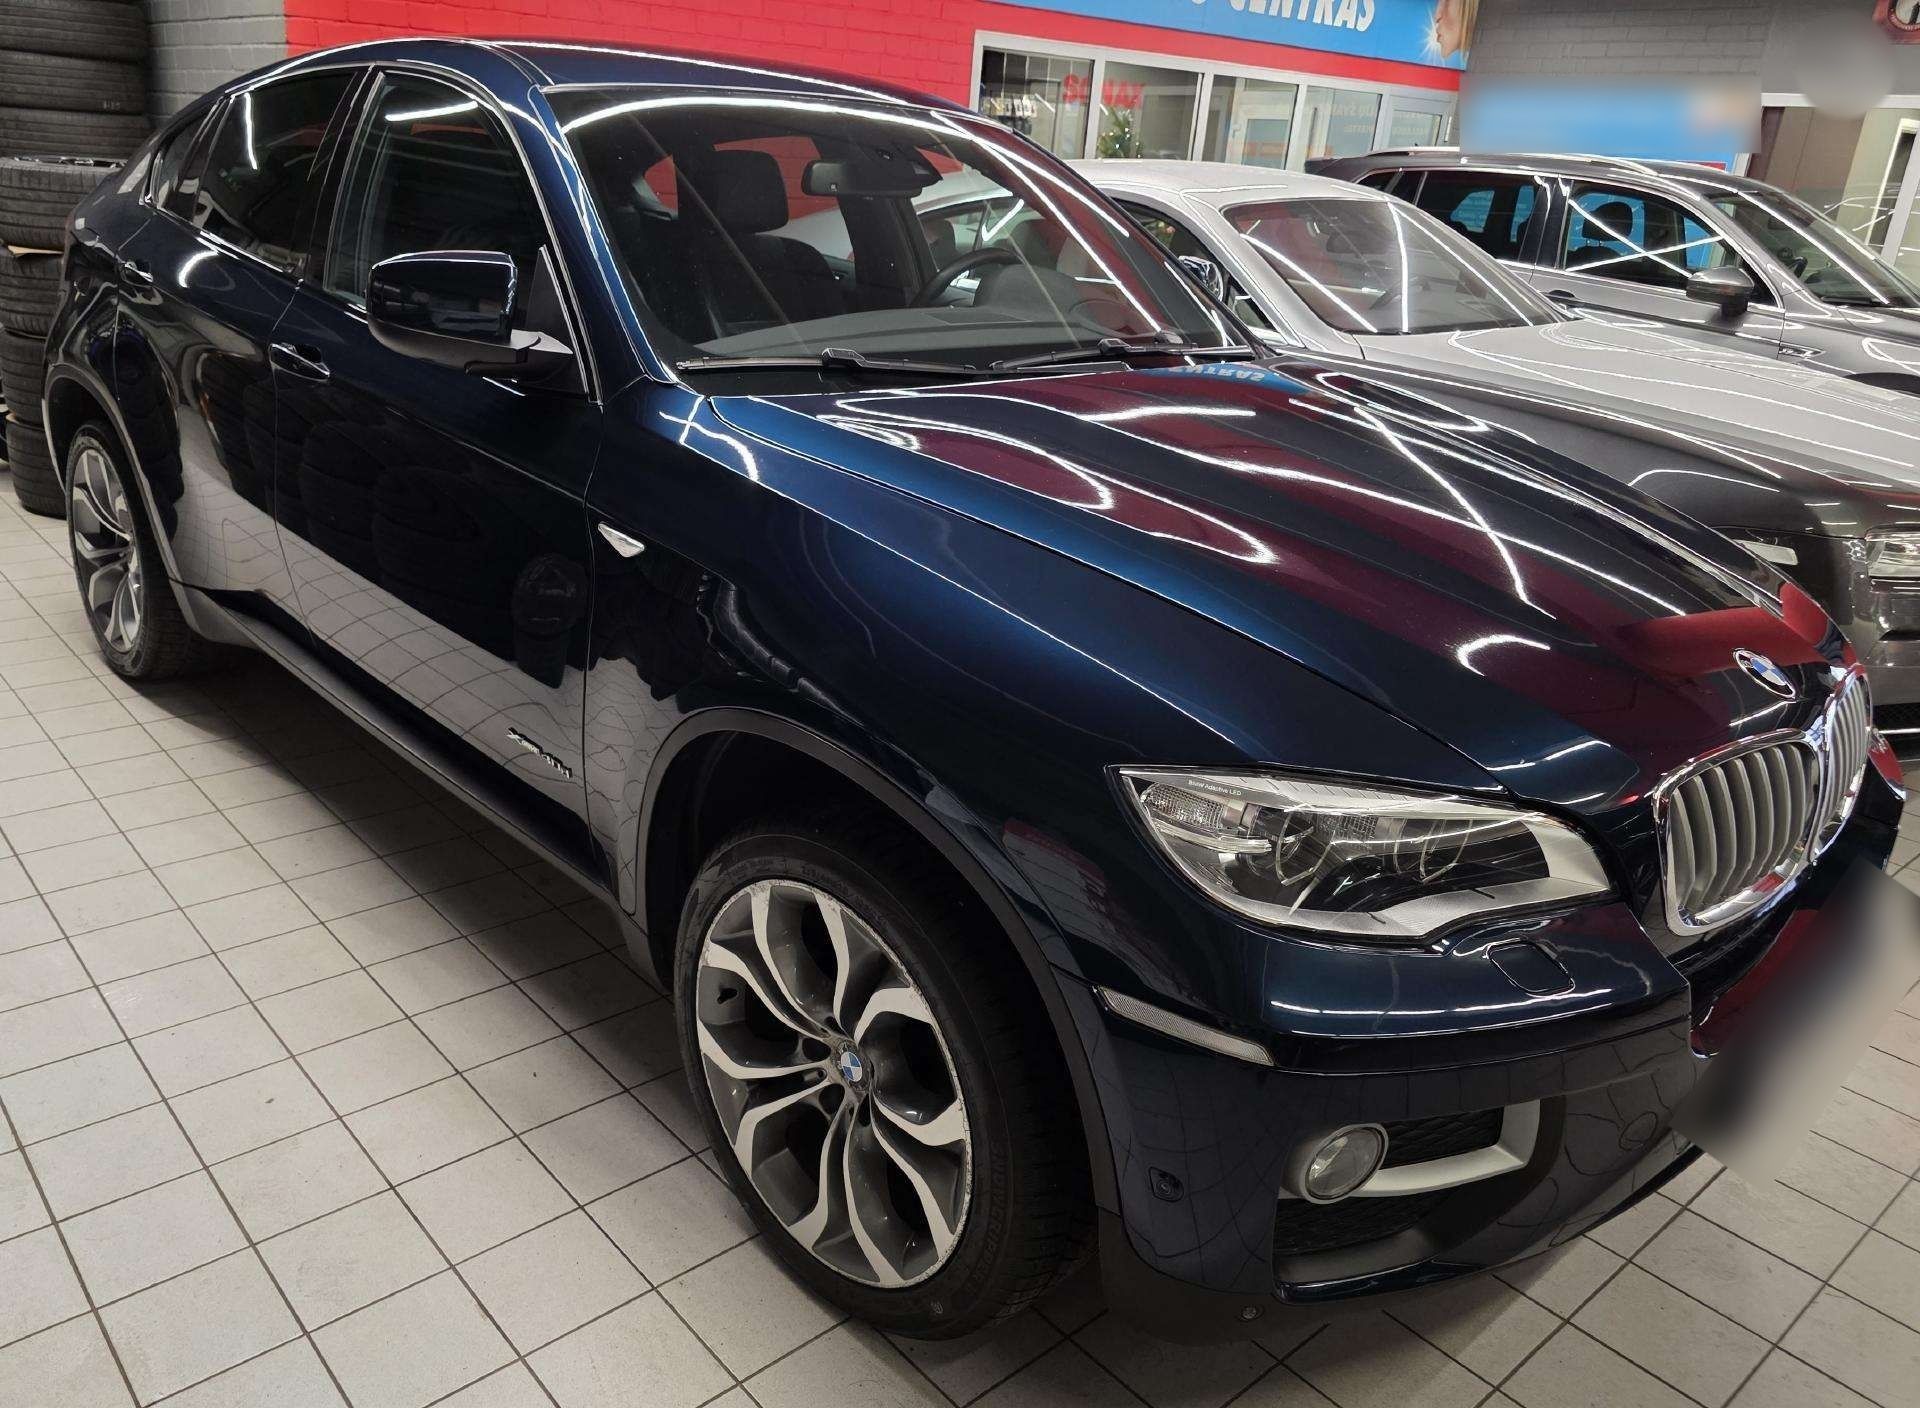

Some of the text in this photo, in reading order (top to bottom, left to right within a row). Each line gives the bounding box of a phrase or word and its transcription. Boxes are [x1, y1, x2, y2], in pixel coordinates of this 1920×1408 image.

[1188, 779, 1242, 796] BMW Adaptive LED
